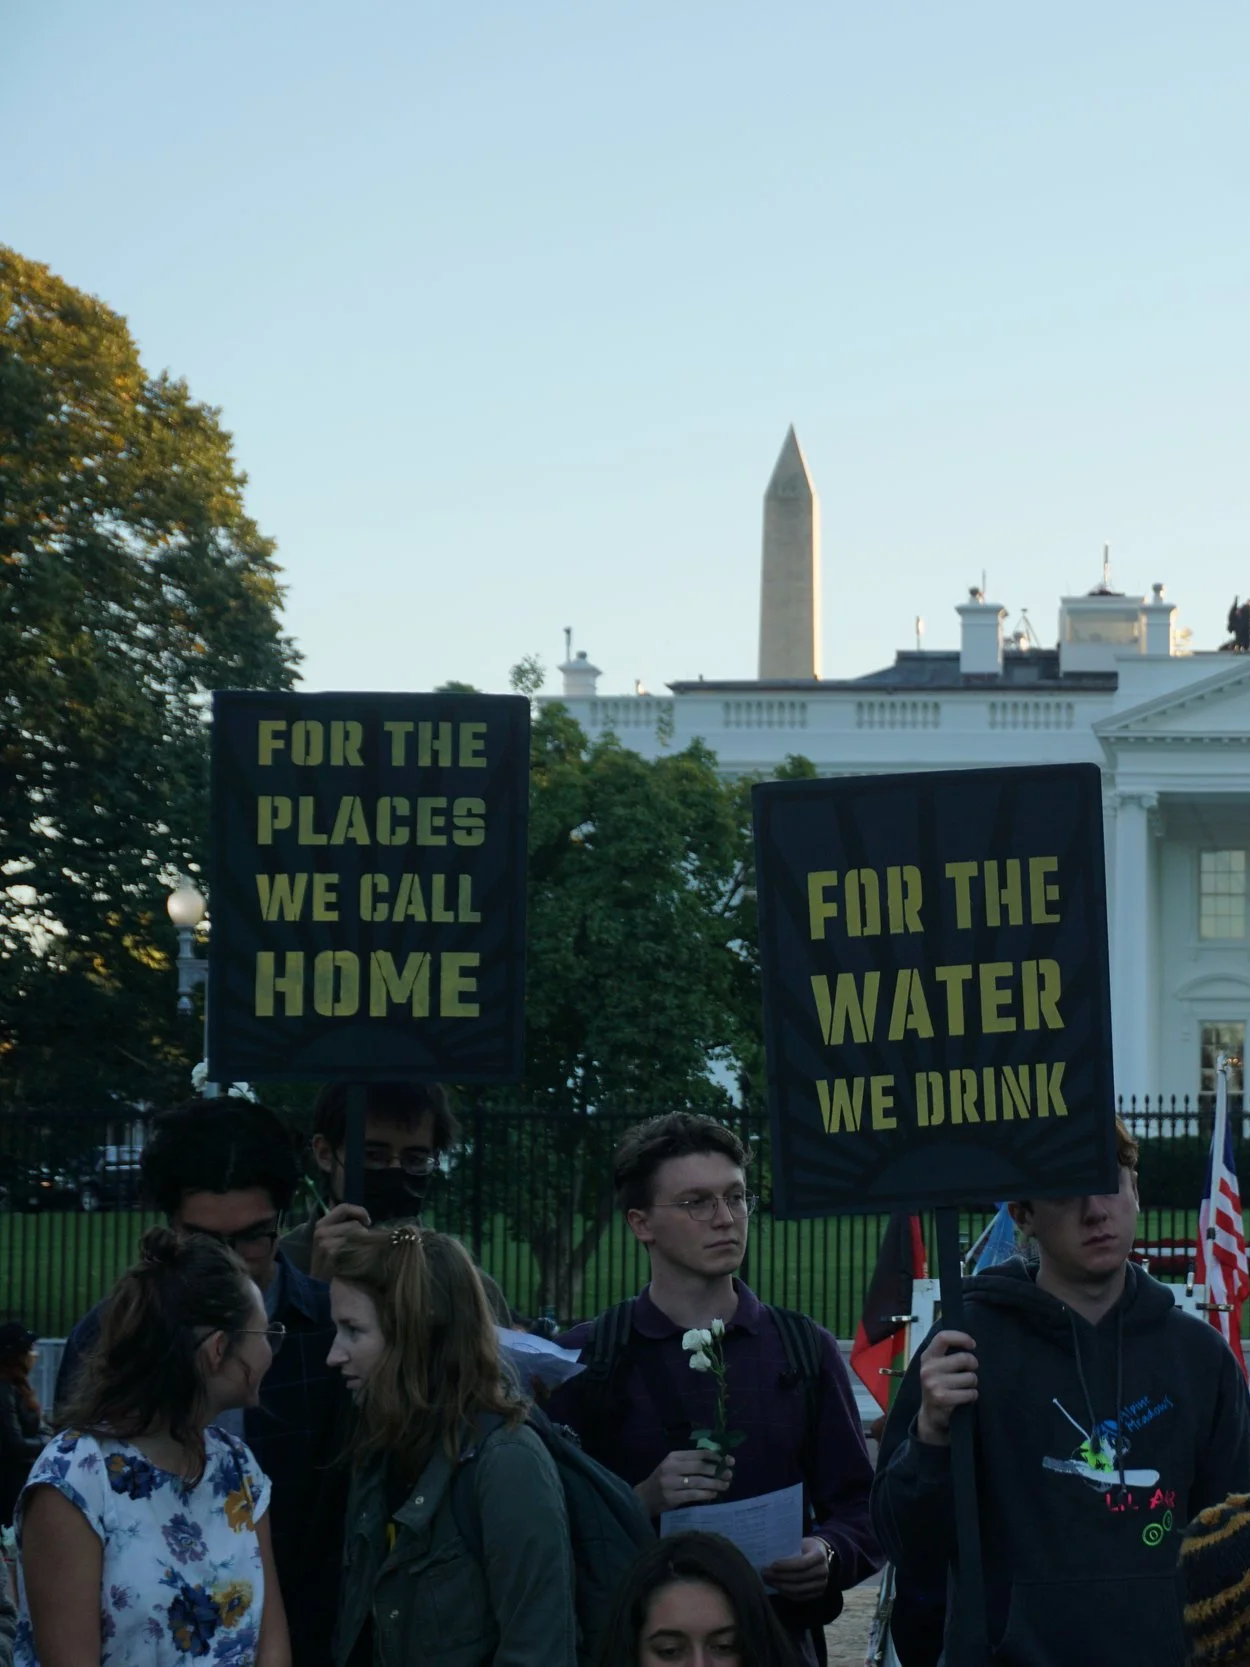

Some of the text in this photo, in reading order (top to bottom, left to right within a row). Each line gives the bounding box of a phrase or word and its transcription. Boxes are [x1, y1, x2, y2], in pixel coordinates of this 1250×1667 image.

[258, 719, 488, 768] FOR THE
[257, 795, 487, 846] PLACES
[255, 872, 482, 923] WE CALL
[807, 856, 1061, 940] FOR THE
[254, 949, 481, 1018] HOME
[810, 958, 1065, 1046] WATER
[815, 1061, 1069, 1134] WE DRINK
